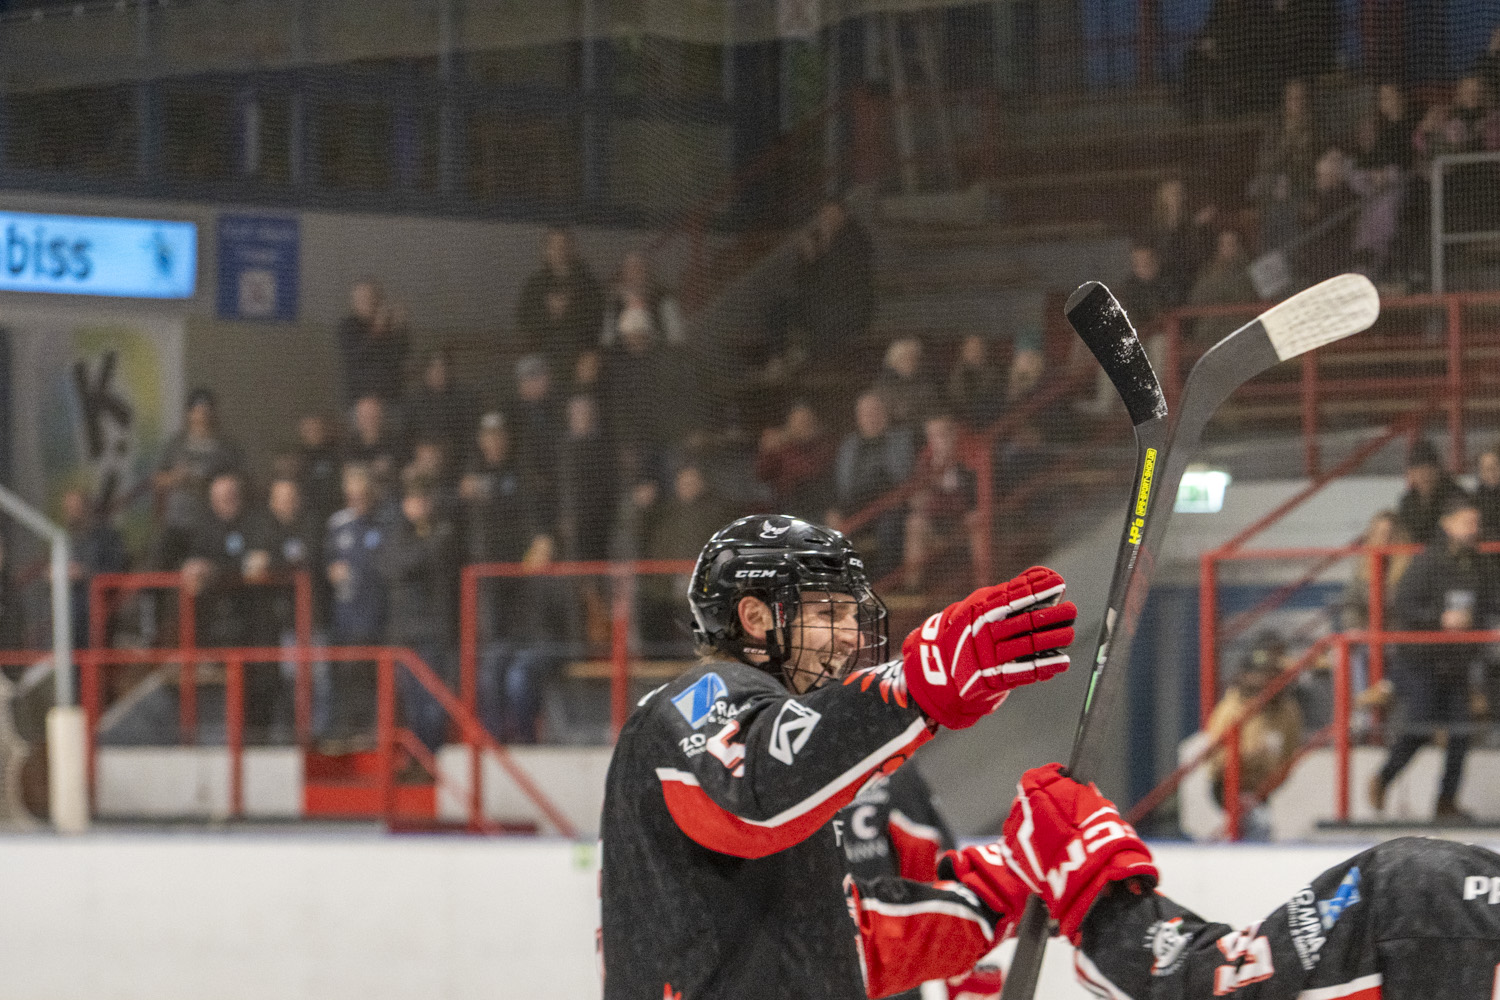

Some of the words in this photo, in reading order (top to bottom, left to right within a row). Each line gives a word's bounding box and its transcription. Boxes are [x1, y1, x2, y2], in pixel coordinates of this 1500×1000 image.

[735, 570, 777, 578] CCM
[920, 612, 948, 686] CC
[851, 804, 879, 840] C
